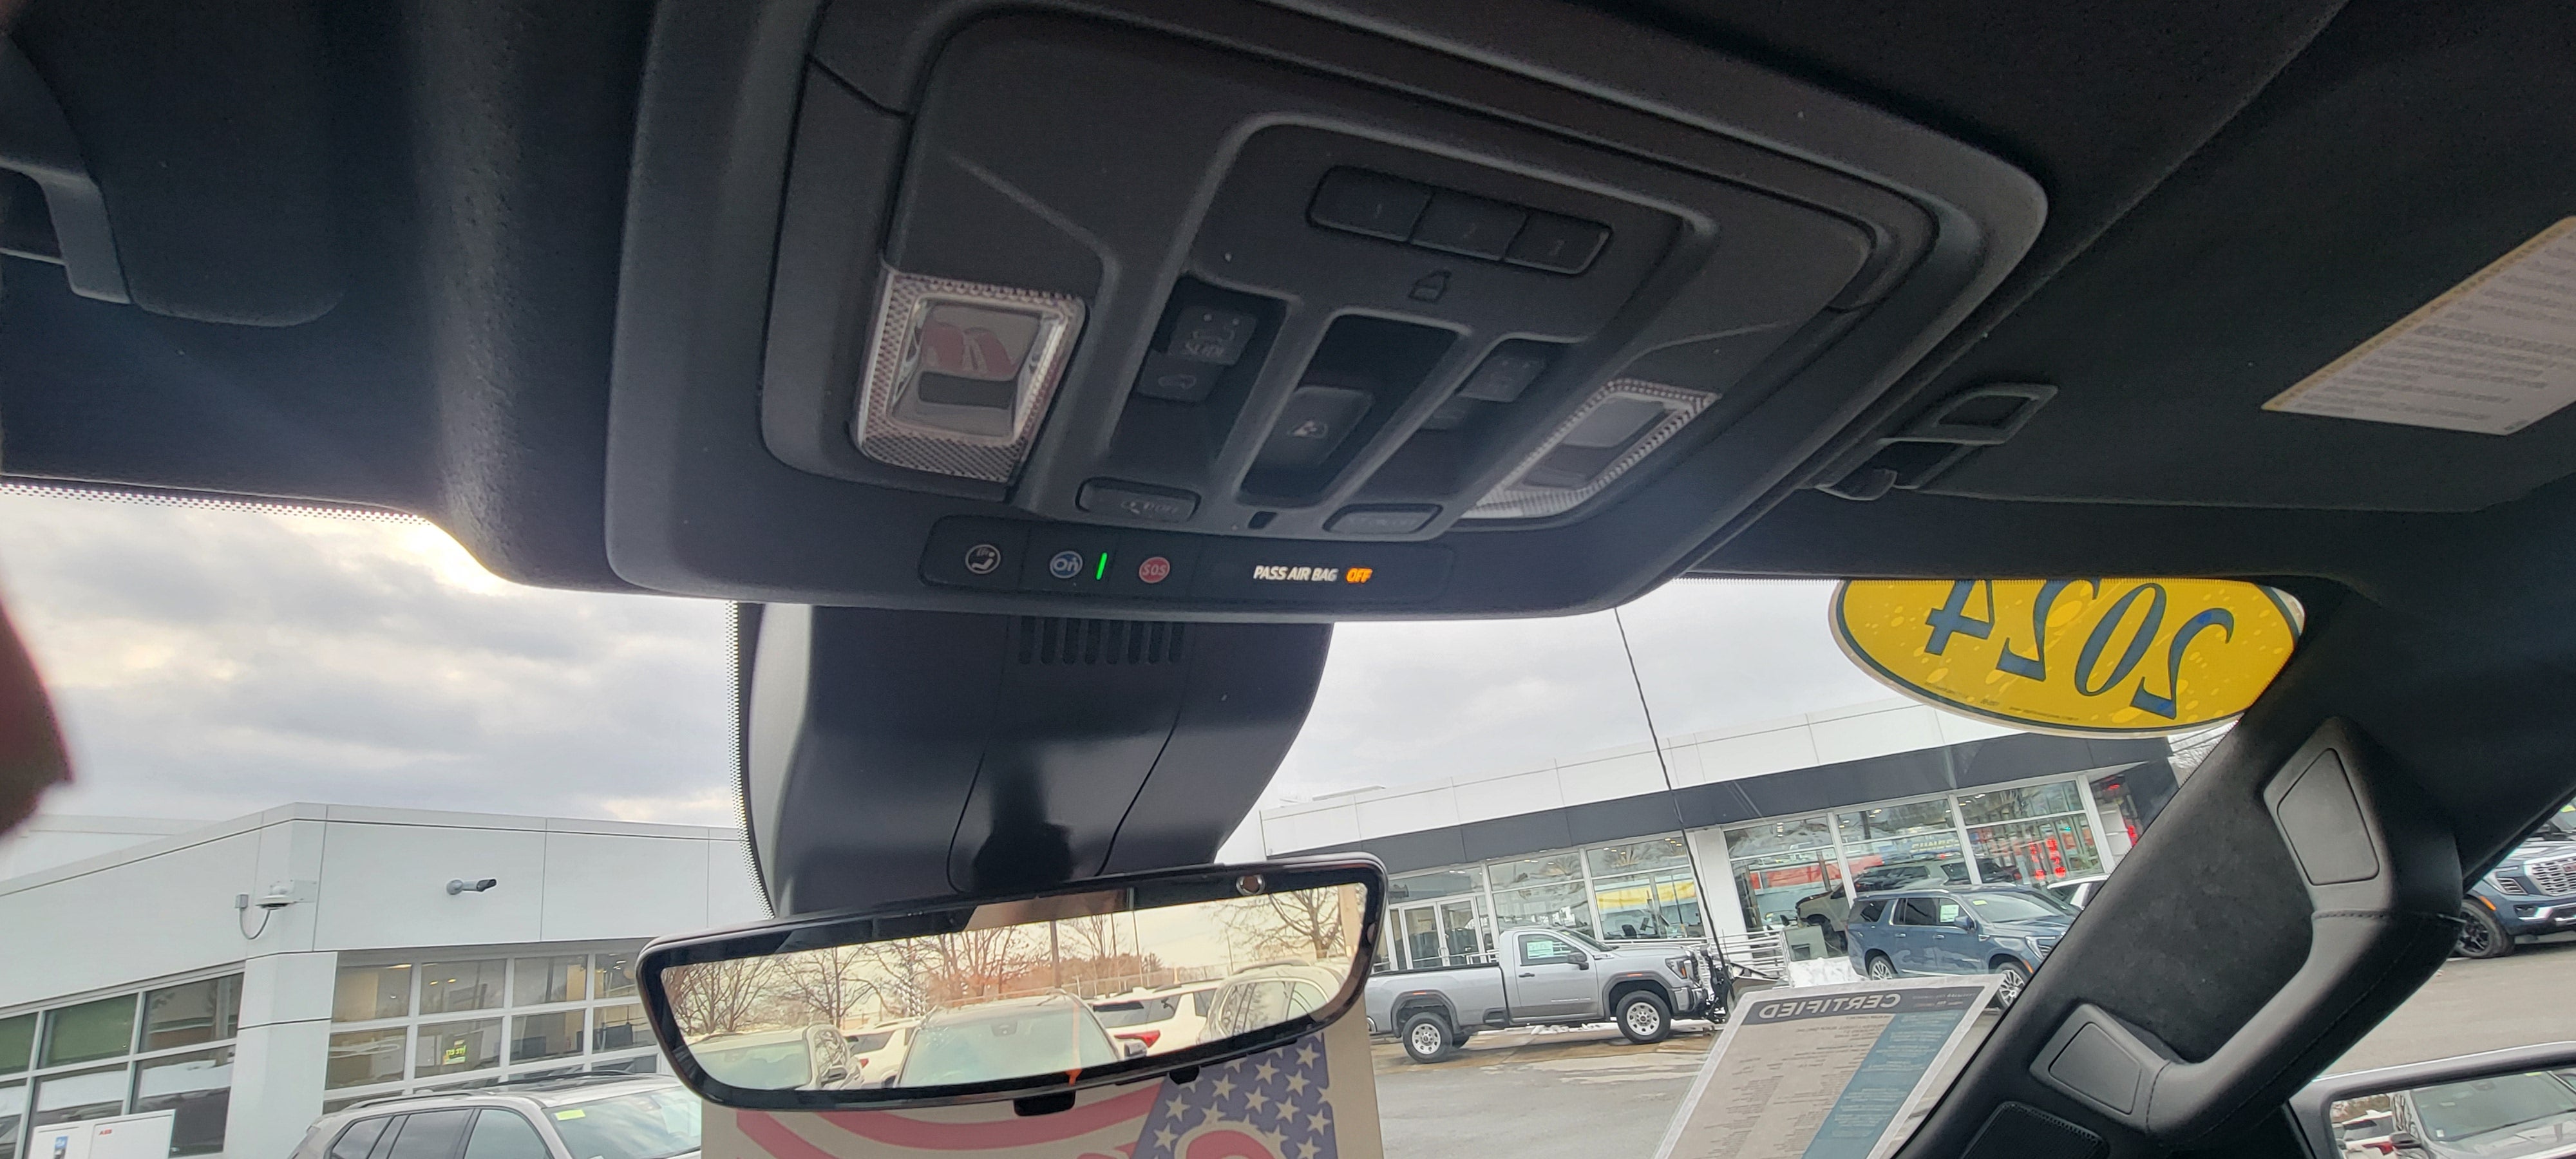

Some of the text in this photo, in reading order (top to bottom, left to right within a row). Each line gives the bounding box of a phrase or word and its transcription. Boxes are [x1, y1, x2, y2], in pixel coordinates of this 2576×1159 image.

[1142, 563, 1167, 576] SOS
[1253, 565, 1373, 583] PASS AIR BAG OFF
